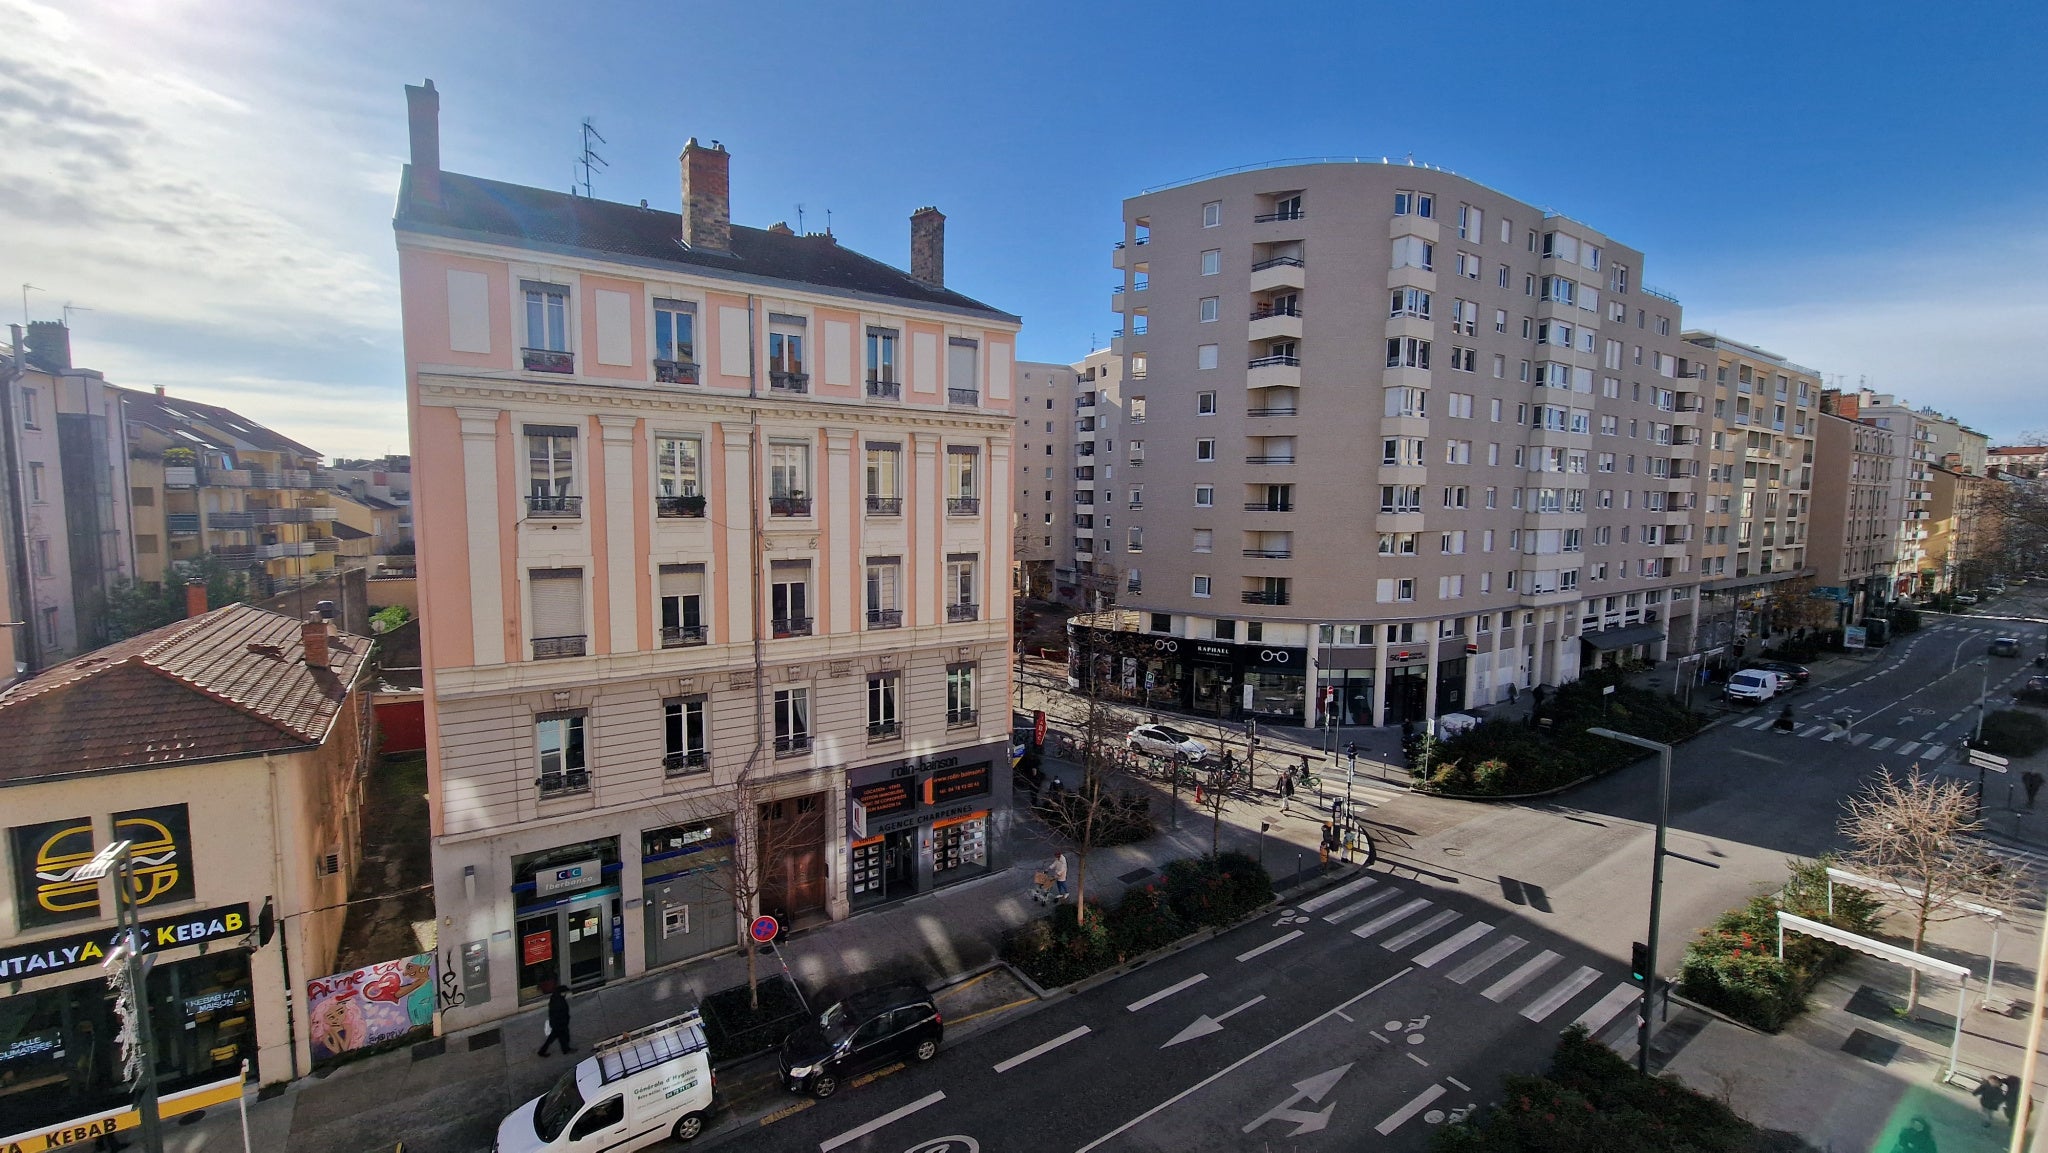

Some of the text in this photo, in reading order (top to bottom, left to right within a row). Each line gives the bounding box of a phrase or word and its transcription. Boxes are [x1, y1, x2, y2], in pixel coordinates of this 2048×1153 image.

[1197, 645, 1229, 654] RAPHAEL
[891, 755, 959, 778] rolin-bainson
[878, 804, 973, 833] AGENCE CHARPENNES
[558, 867, 581, 880] CIC
[545, 876, 593, 891] Iberbanco
[157, 912, 243, 946] KEBAB
[190, 989, 241, 1007] KEBAB FAIT
[199, 998, 234, 1011] MAISON
[10, 1036, 41, 1050] SALLE
[45, 1118, 117, 1149] KEBAB
